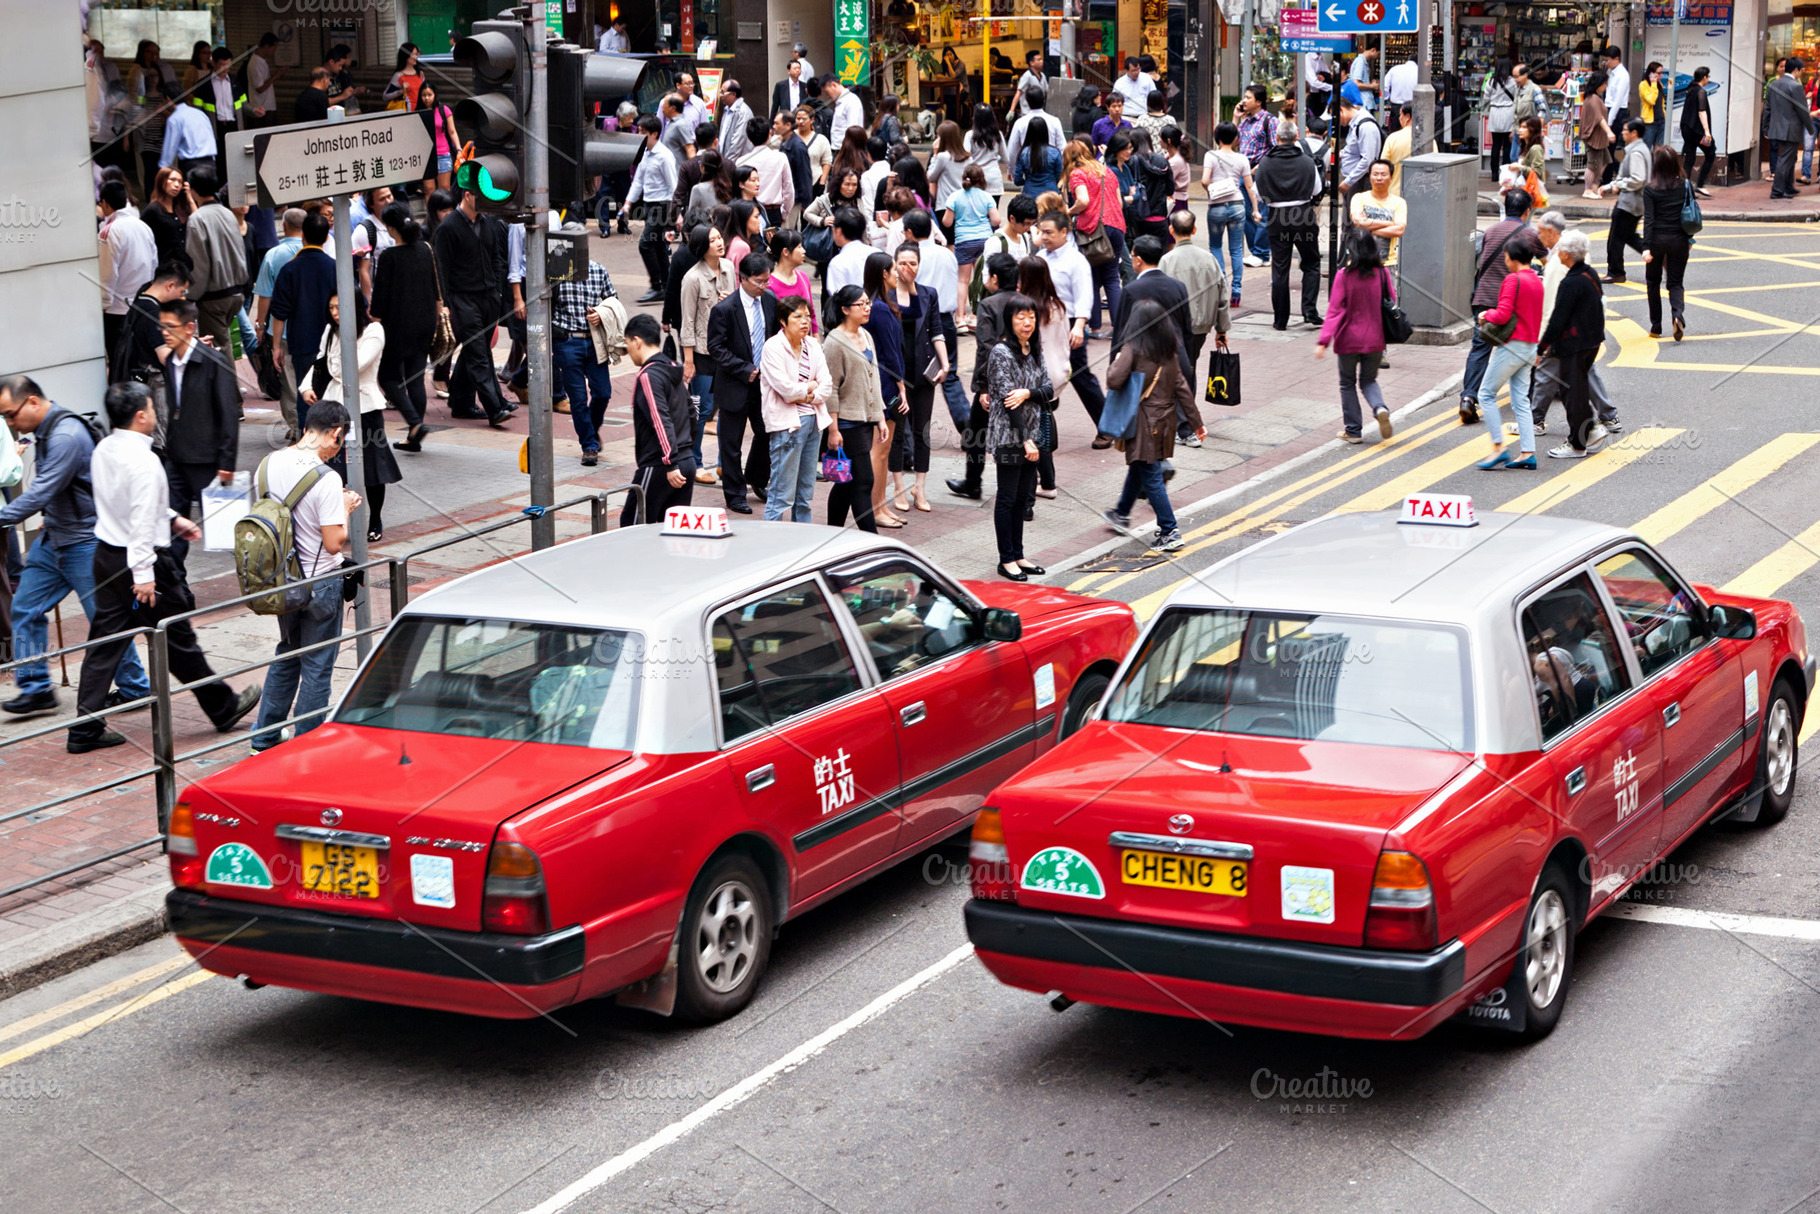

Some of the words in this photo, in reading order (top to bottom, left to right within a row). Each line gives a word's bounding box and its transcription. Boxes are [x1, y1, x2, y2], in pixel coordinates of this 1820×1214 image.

[839, 1, 851, 31] 大王
[304, 135, 358, 156] Johnston
[361, 127, 393, 147] Road
[279, 174, 308, 190] 25-111
[315, 156, 385, 188] 莊士敦道
[389, 155, 422, 171] 123-181
[669, 512, 712, 530] TAXI
[1408, 499, 1460, 519] TAXI
[813, 747, 852, 787] 的士
[1613, 749, 1637, 790] 的士
[816, 773, 855, 815] TAXI
[1614, 780, 1639, 823] TAXI
[215, 846, 254, 862] TAXI
[230, 856, 243, 873] 5
[324, 843, 355, 868] GS
[1036, 851, 1084, 868] TAXI
[217, 872, 261, 885] SEATS
[311, 864, 370, 896] 7122
[1054, 862, 1070, 880] 5
[1123, 853, 1215, 887] CHENG
[1229, 865, 1247, 891] 8
[1036, 877, 1090, 894] SEATS
[1467, 1006, 1511, 1020] TOYOTA
